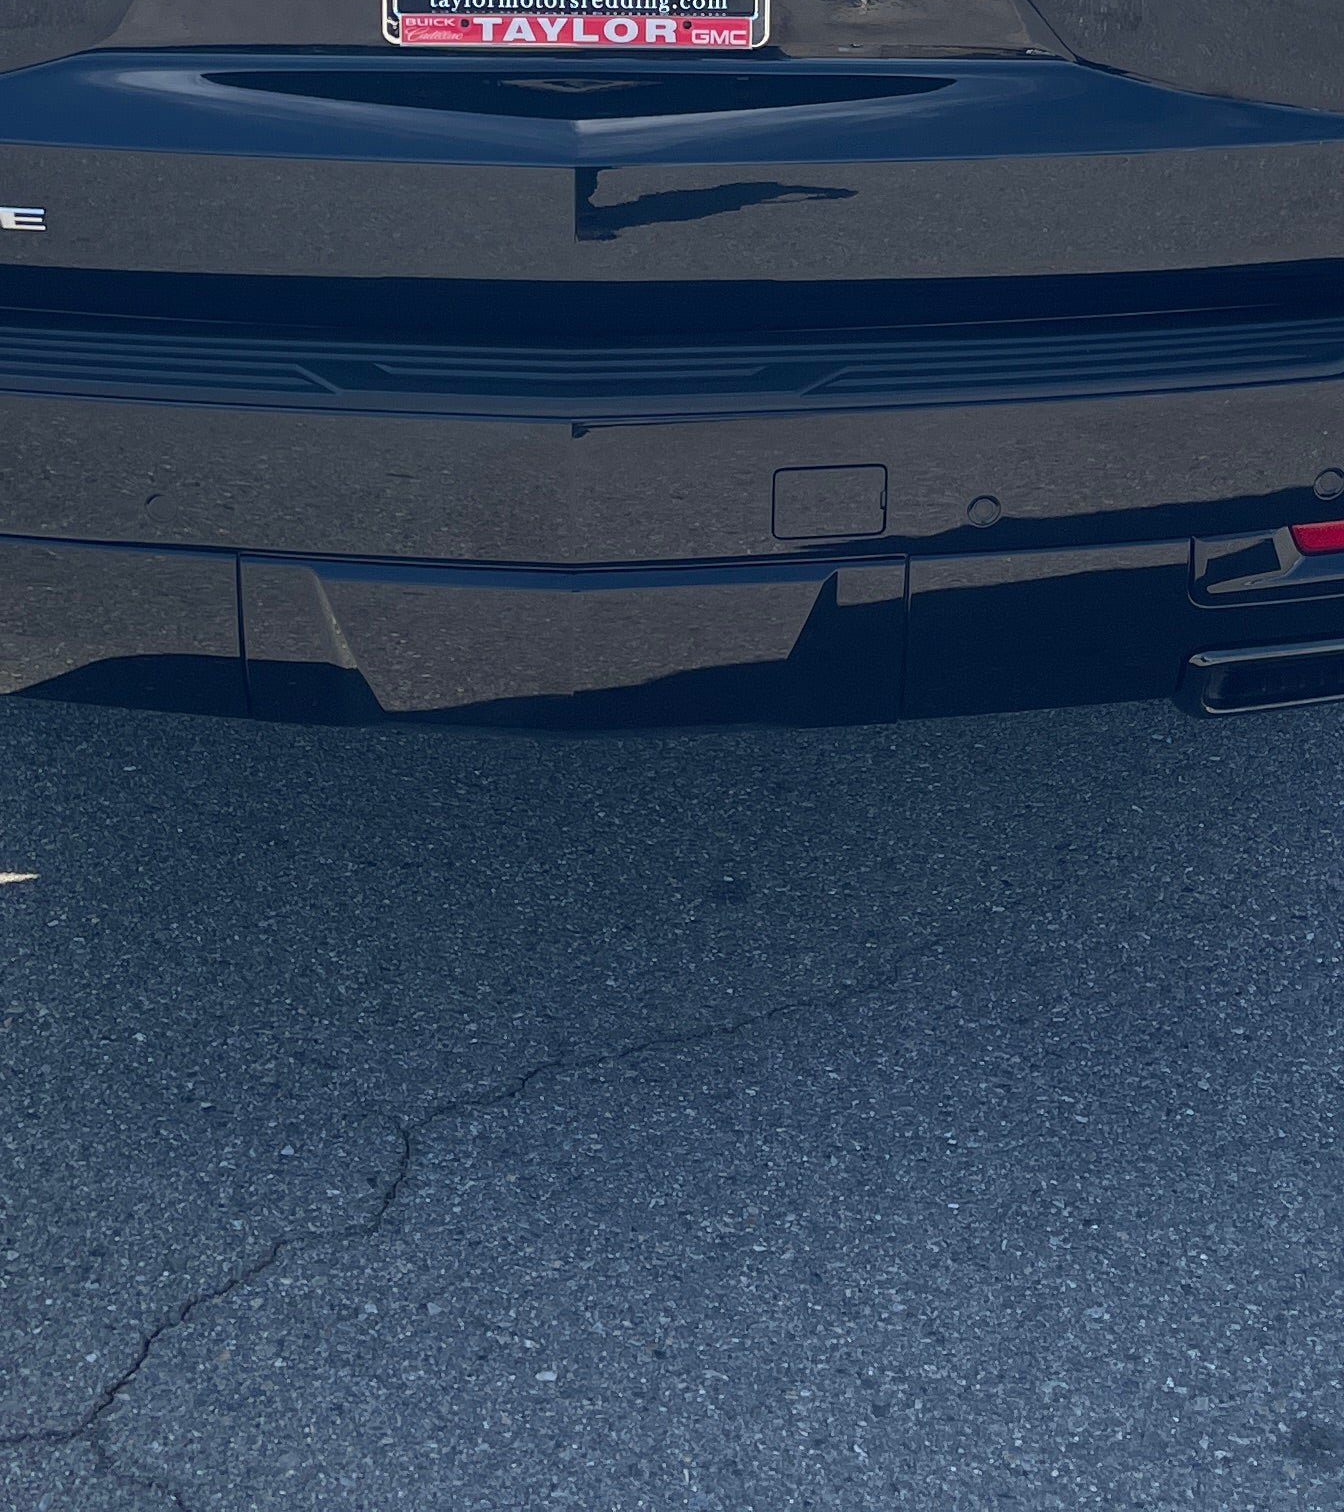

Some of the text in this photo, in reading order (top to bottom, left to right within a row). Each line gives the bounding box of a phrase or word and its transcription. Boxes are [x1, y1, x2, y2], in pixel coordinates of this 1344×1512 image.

[406, 18, 455, 27] BUICK
[473, 17, 677, 43] TAYLOR
[691, 29, 747, 45] GMC
